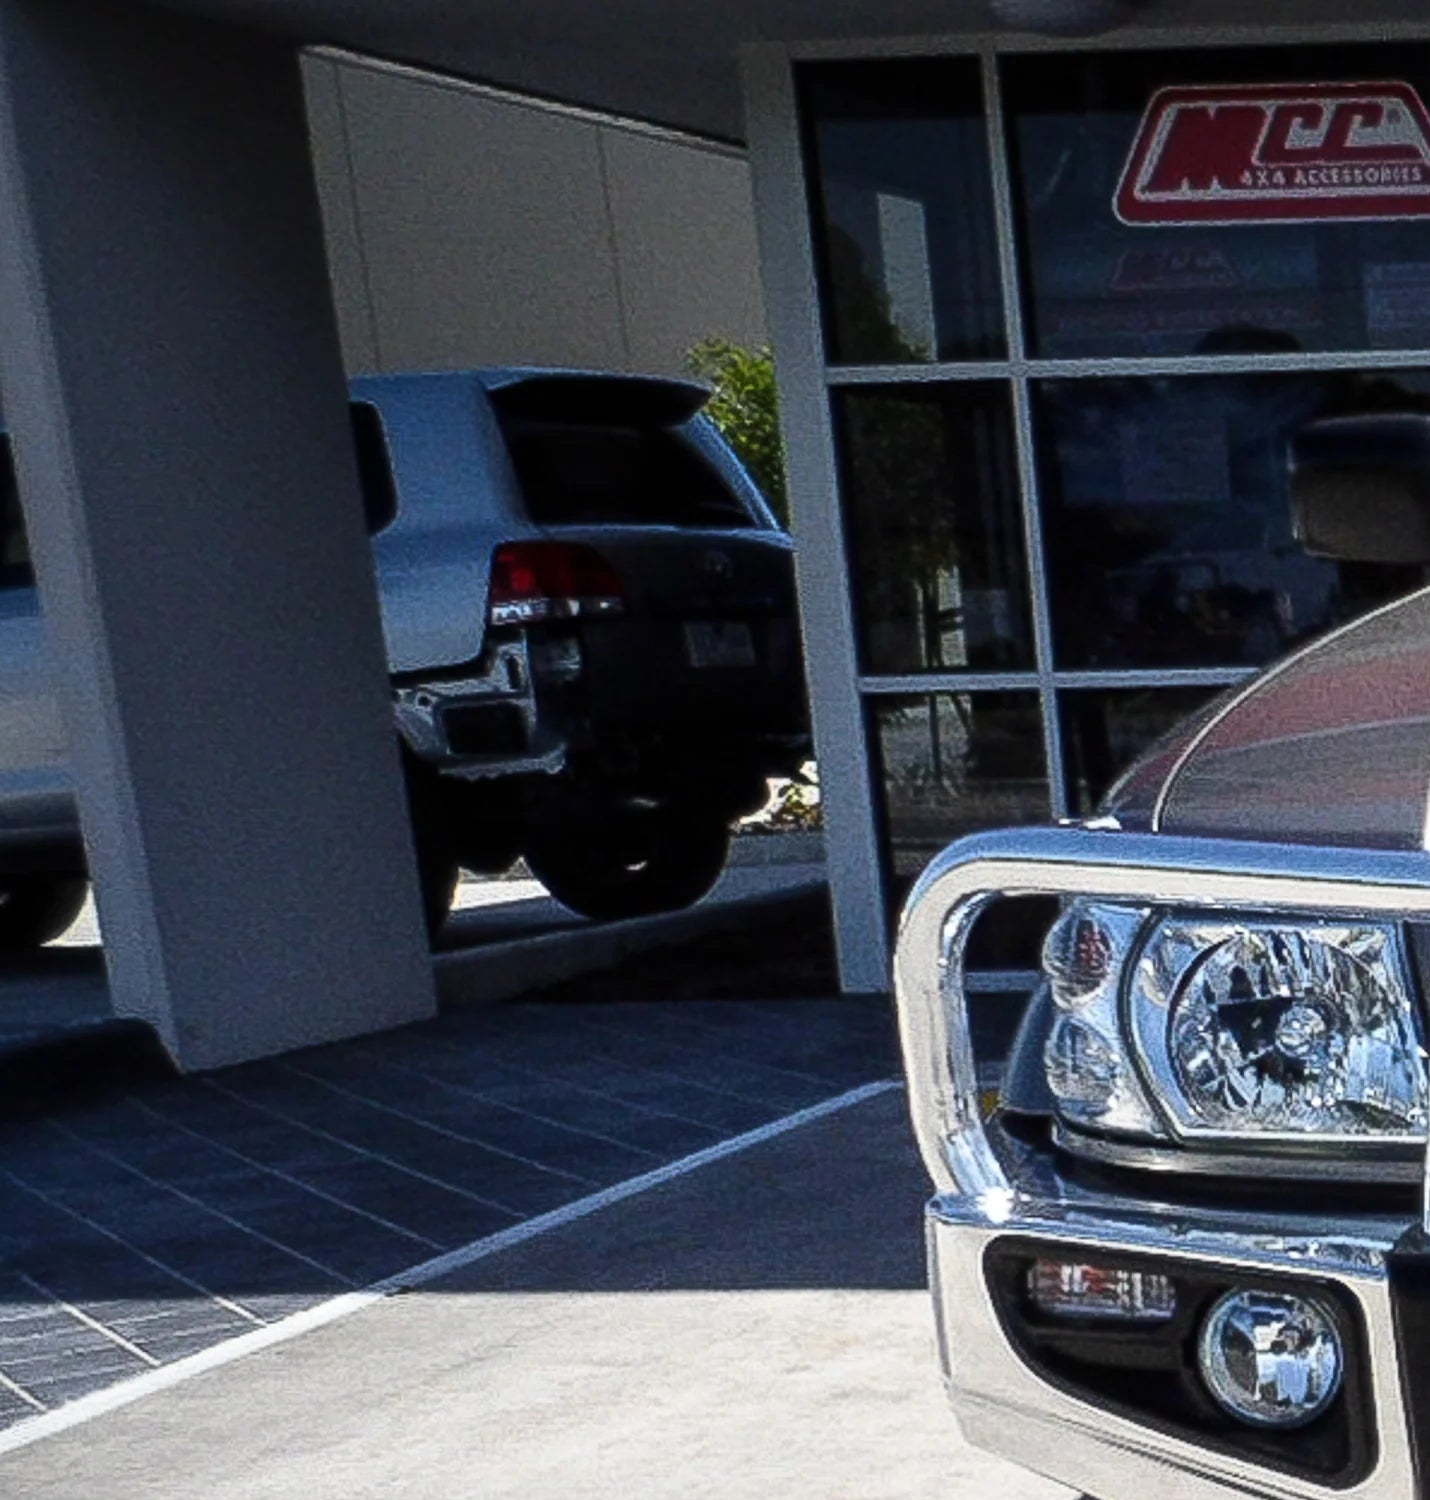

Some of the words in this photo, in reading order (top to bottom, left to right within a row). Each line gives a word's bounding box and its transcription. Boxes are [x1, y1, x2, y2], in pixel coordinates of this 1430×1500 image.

[1143, 102, 1424, 190] MCC
[1240, 168, 1286, 187] 4X4
[1294, 166, 1422, 187] ACCESSORIES
